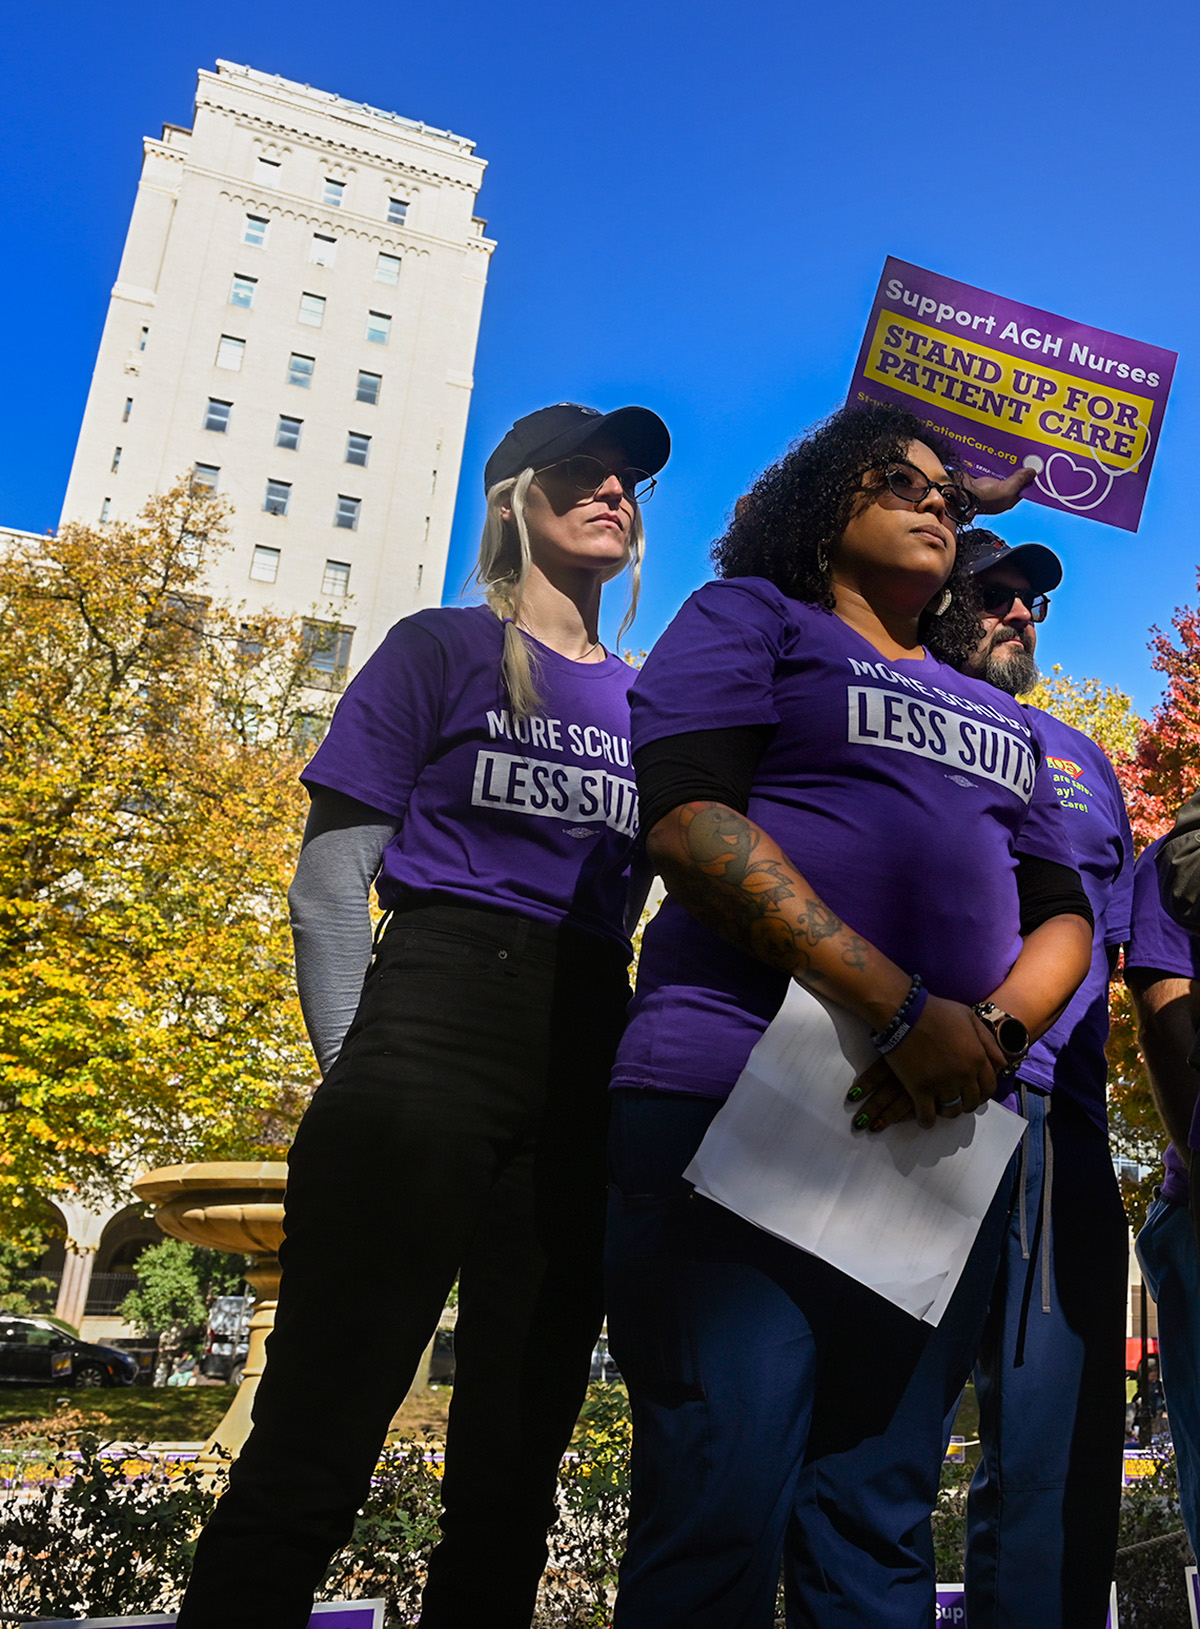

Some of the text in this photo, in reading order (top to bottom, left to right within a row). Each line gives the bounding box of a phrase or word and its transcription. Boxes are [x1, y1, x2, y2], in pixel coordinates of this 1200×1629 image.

[885, 279, 1161, 388] Support AGH Nurses
[875, 350, 1137, 458] PATIENT CARE
[883, 324, 1141, 430] STAND UP FOR
[847, 657, 936, 698] MORE
[486, 709, 634, 770] MORE SCRU
[858, 692, 1036, 795] LESS SUITS
[481, 757, 569, 812] LESS
[935, 1602, 964, 1624] Sup
